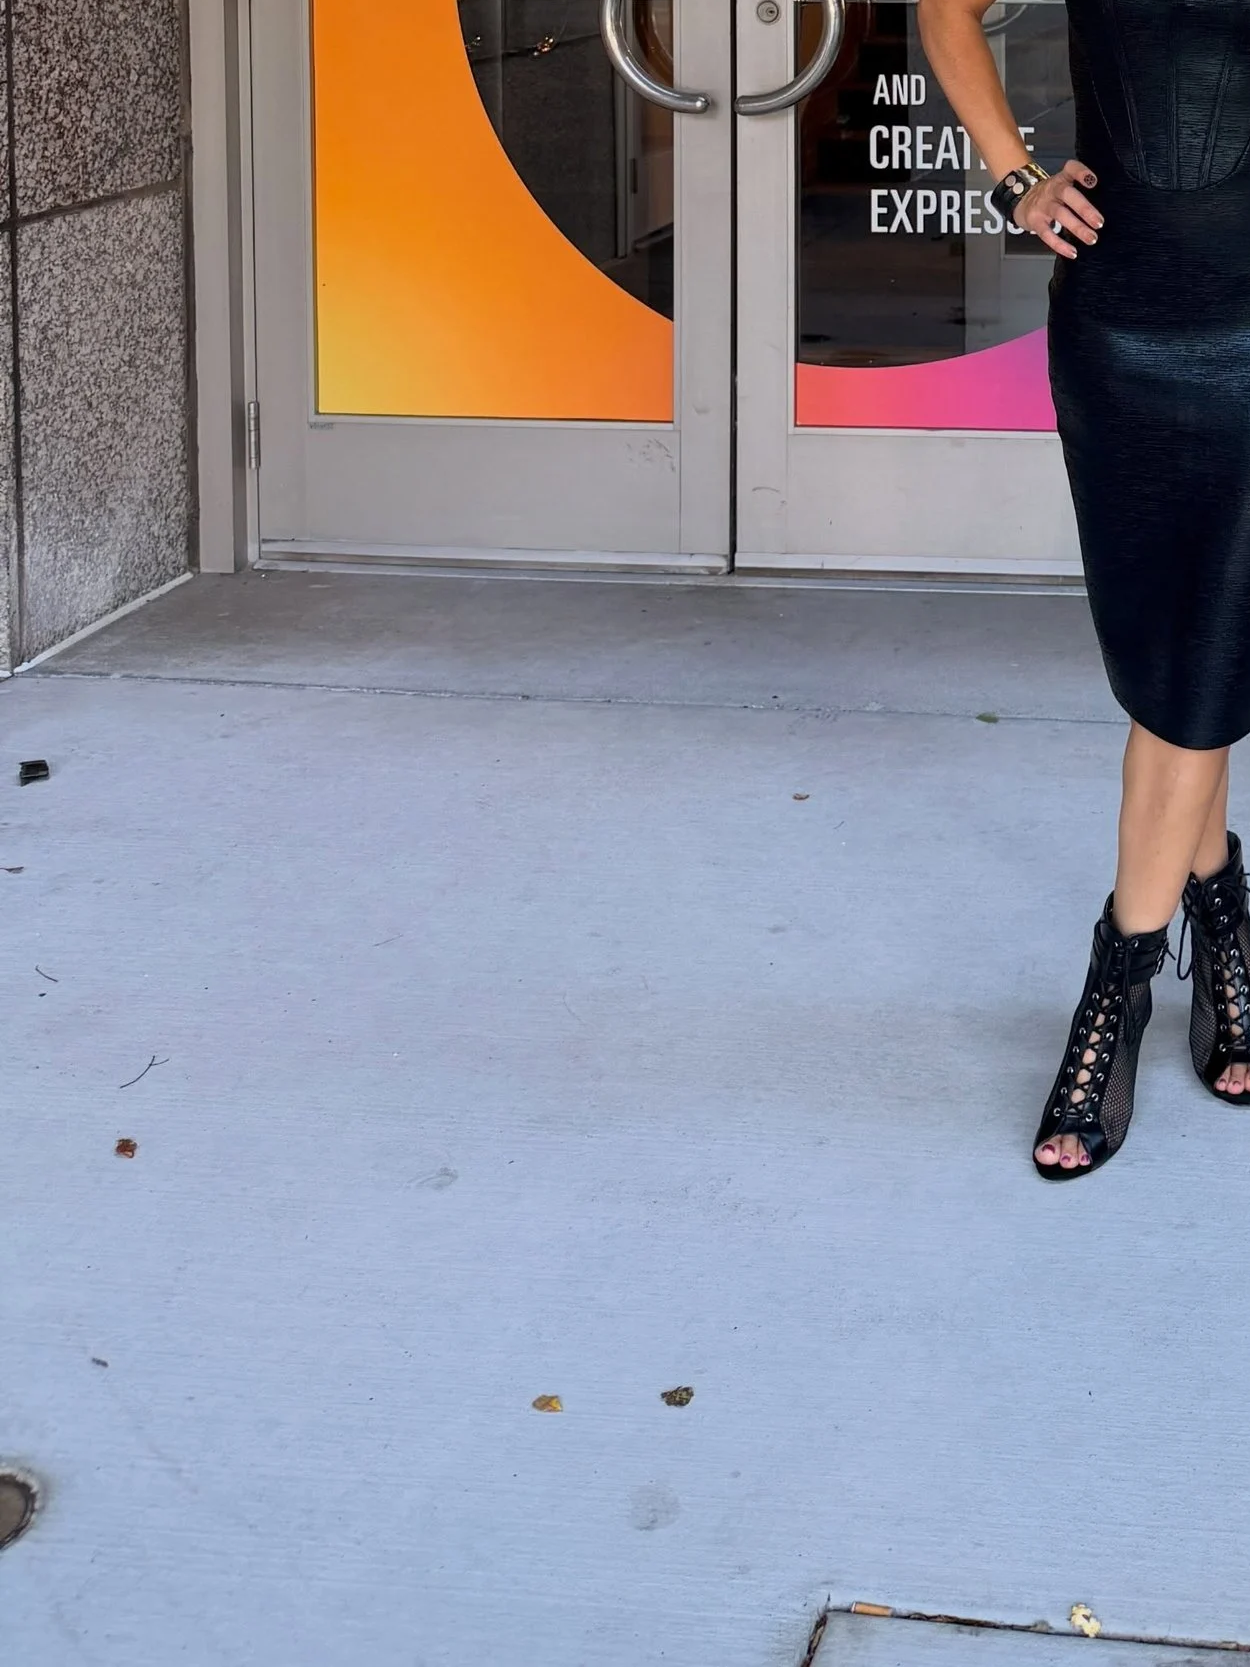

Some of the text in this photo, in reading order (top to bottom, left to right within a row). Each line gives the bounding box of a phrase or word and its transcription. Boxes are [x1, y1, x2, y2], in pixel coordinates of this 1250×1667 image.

[873, 74, 926, 105] AND
[869, 125, 1036, 170] CREAT
[870, 189, 1062, 234] EXPRES
